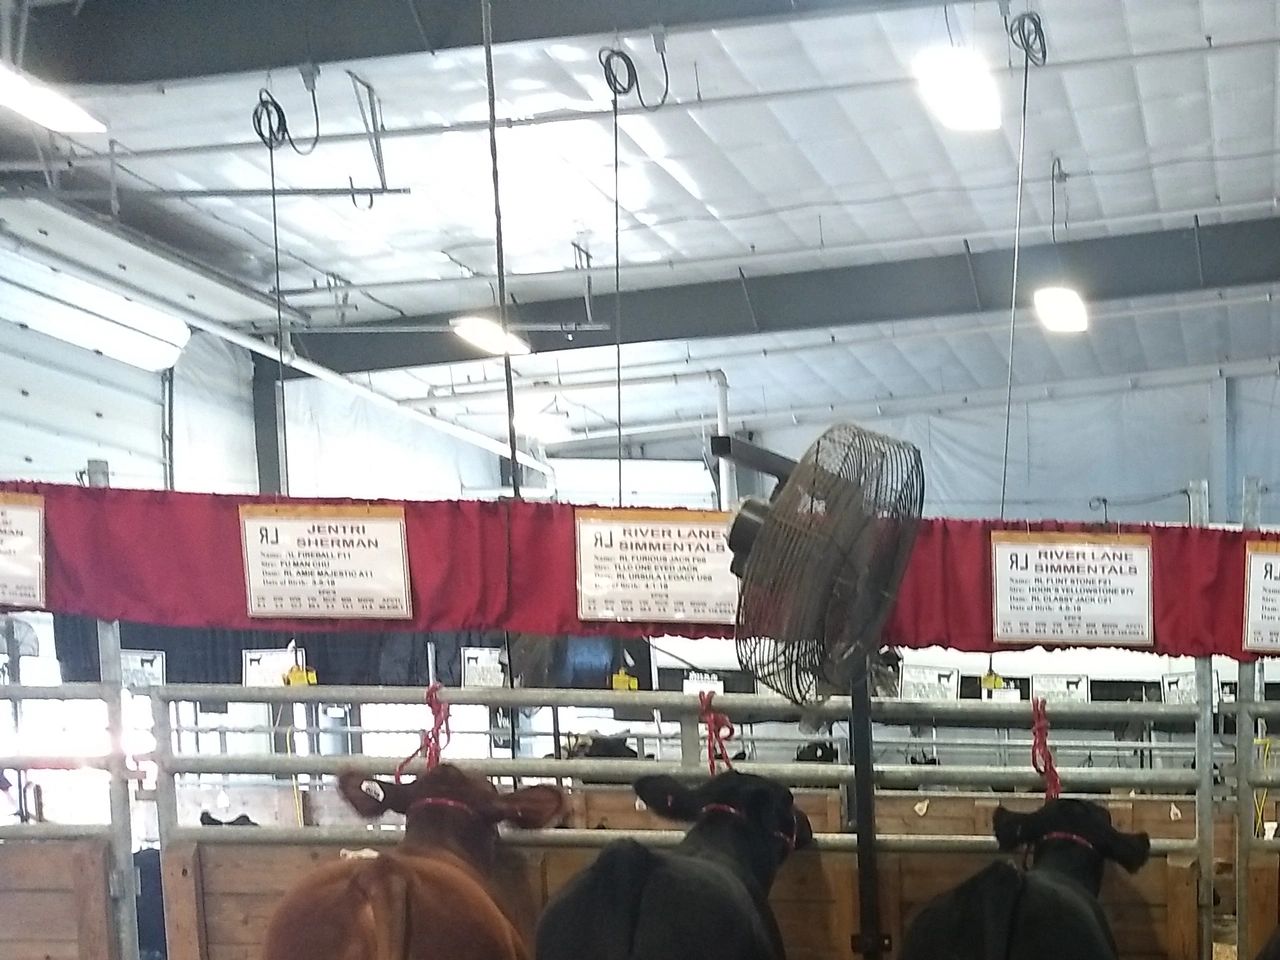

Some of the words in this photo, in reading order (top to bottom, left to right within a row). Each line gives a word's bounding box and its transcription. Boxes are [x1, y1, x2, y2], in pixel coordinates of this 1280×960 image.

[307, 525, 366, 535] JENTRI
[623, 528, 672, 538] RIVER
[297, 538, 379, 548] SHERMAN
[619, 542, 725, 553] SIMMENTALS
[1038, 551, 1086, 561] RIVER
[1092, 552, 1134, 561] LANE
[1035, 564, 1137, 575] SIMMENTALS
